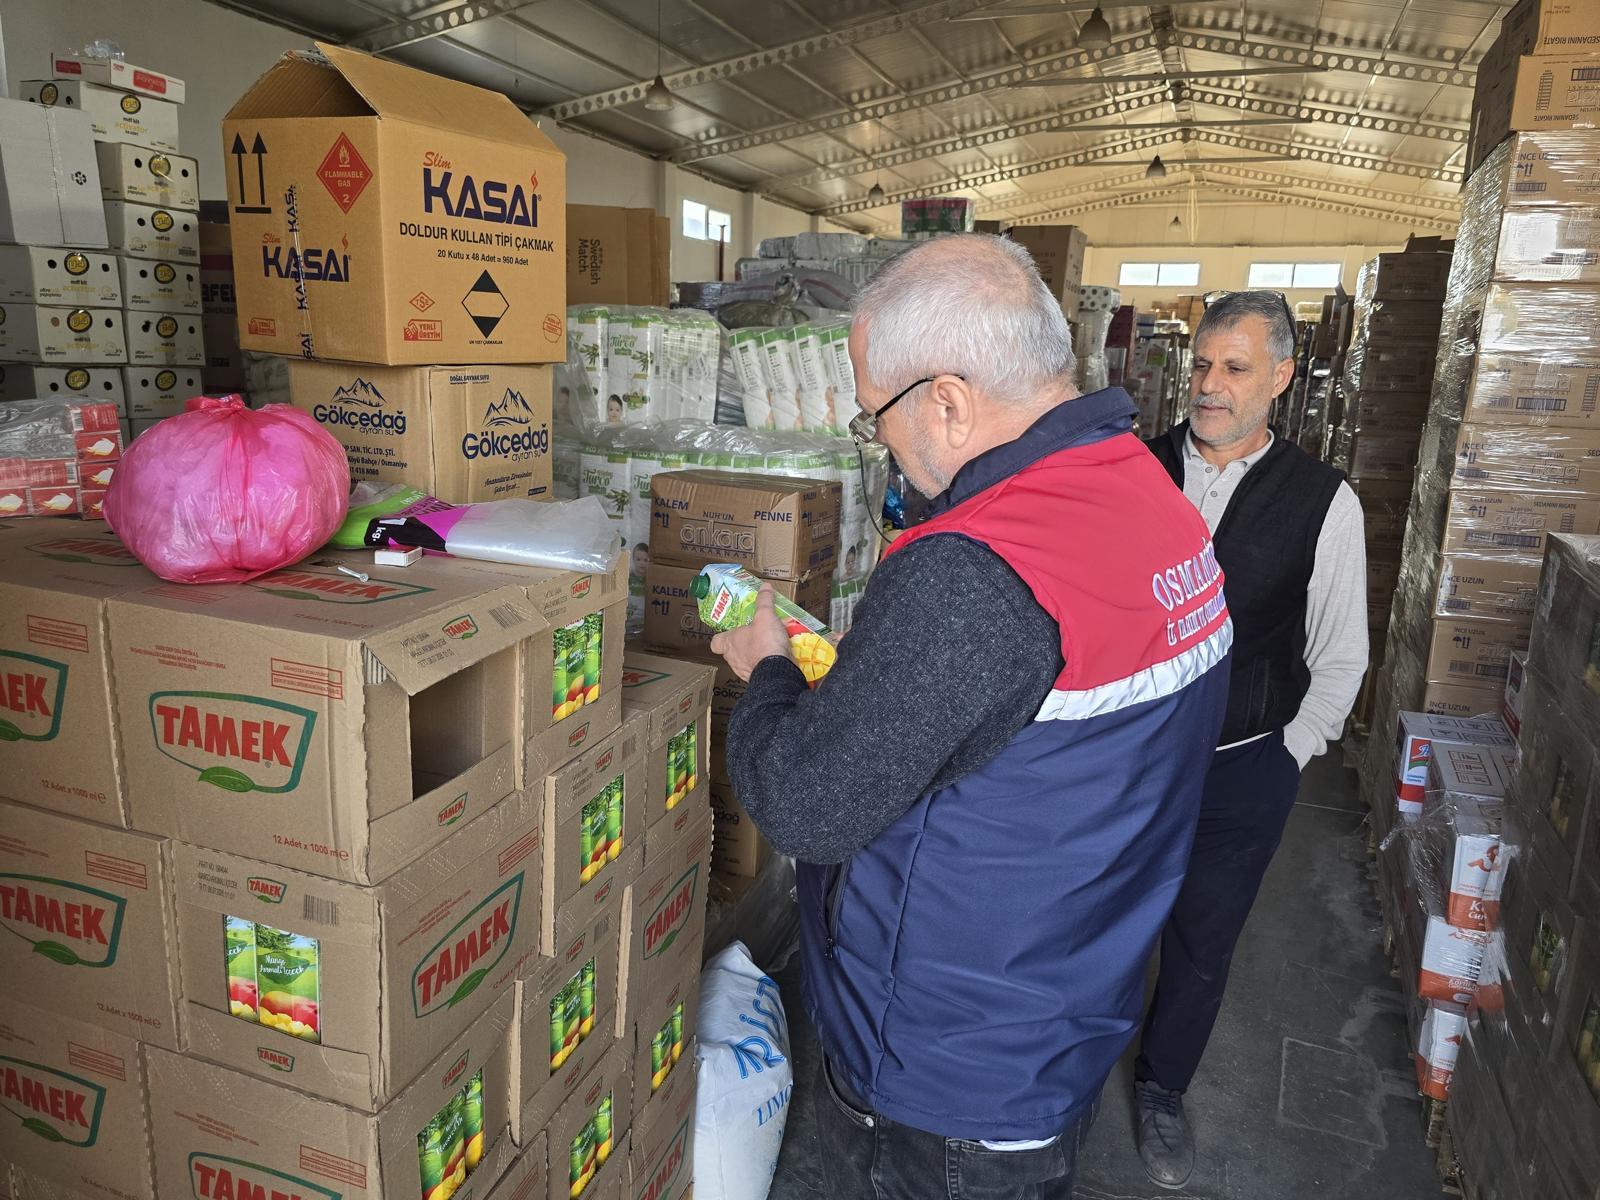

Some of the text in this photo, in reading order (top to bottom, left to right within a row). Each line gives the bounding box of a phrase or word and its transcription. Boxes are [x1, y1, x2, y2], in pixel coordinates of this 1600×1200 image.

[423, 151, 452, 169] Slim
[325, 170, 364, 179] FLAMMABLE
[337, 179, 351, 187] GAS
[343, 194, 350, 203] 2
[262, 233, 281, 244] Slim
[400, 222, 554, 252] DOLDUR KULLAN TİPİ ÇAKMAK
[437, 249, 447, 257] 20
[448, 251, 465, 260] Kutu
[471, 253, 480, 261] 48
[480, 254, 496, 263] Adet
[515, 257, 529, 266] Adet
[579, 238, 589, 273] Match
[590, 239, 600, 285] Swedish
[419, 323, 436, 331] YERLİ
[419, 330, 441, 339] ÜRETİM
[313, 404, 407, 435] Gökçedağ
[462, 423, 549, 460] Gökçedağ
[655, 497, 689, 511] KALEM
[703, 511, 735, 521] NUH'UN
[754, 511, 792, 522] PENNE
[680, 520, 756, 553] ankara
[572, 580, 589, 595] TAMEK
[652, 585, 688, 598] KALEM
[711, 590, 730, 620] TAMEK
[446, 619, 475, 637] TAMEK
[156, 704, 292, 767] TAMEK
[439, 799, 464, 823] TAMEK
[272, 834, 283, 844] 12
[283, 837, 302, 849] Adet
[309, 842, 329, 855] 1000
[249, 880, 282, 898] TAMEK
[0, 885, 109, 945] TAMEK
[645, 879, 691, 951] TAMEK
[417, 898, 510, 1008] TAMEK
[259, 1050, 290, 1067] TAMEK
[443, 1058, 466, 1086] TAMEK
